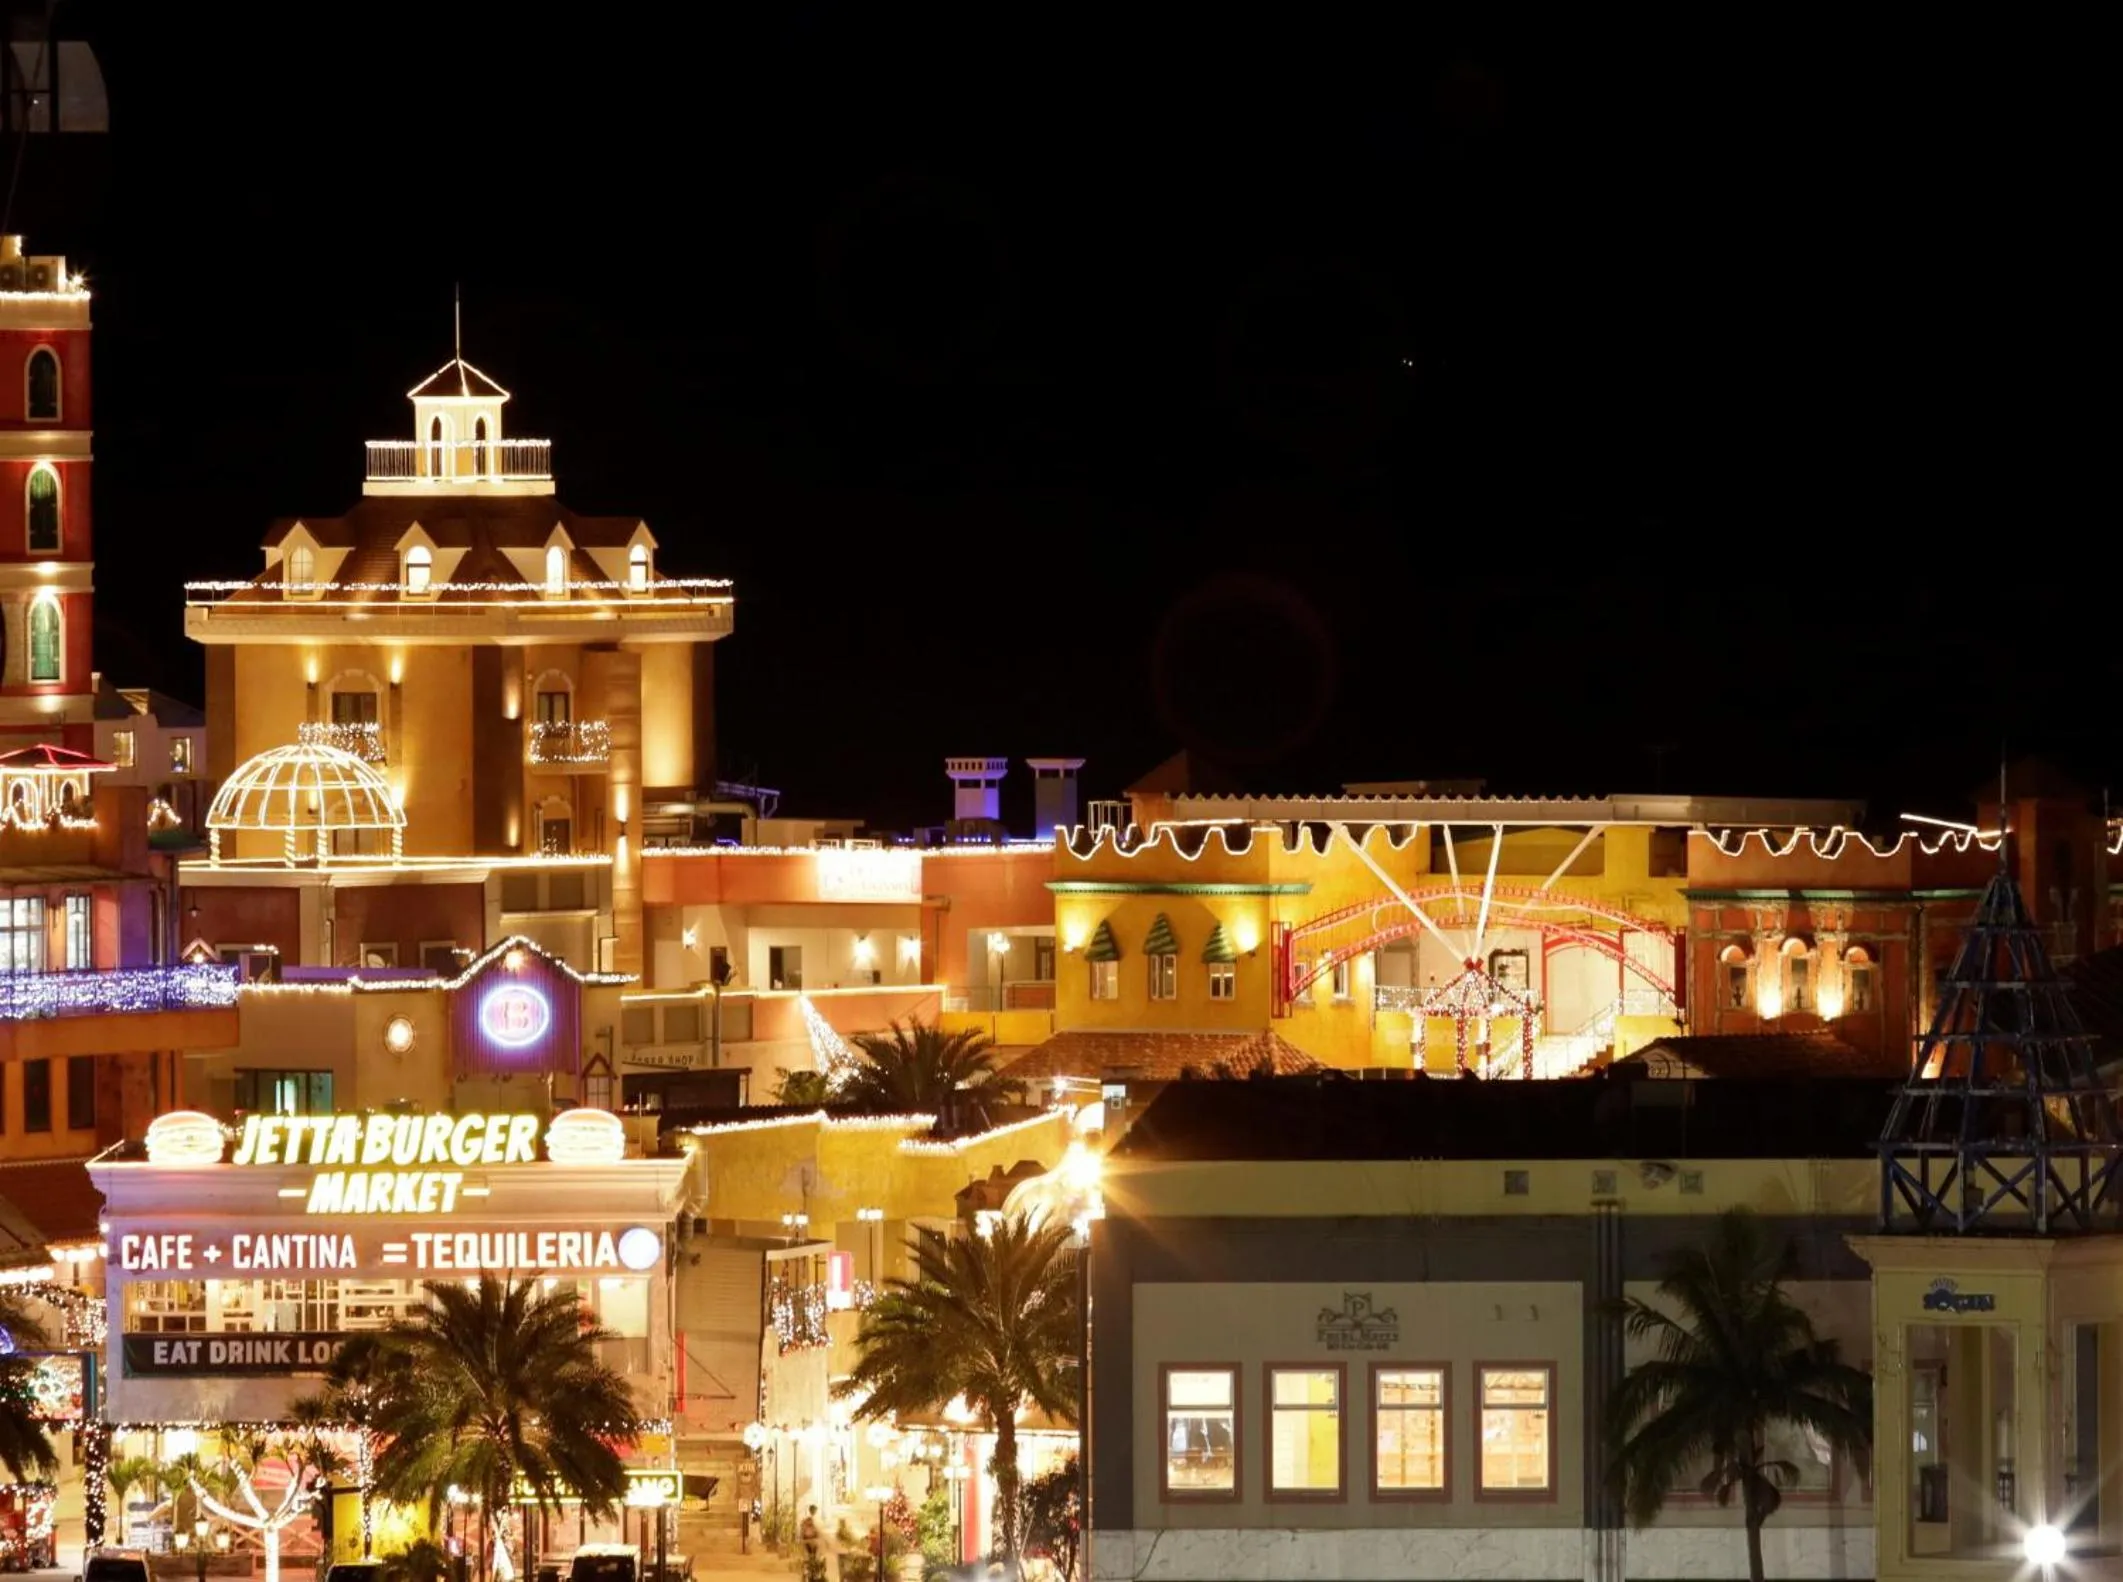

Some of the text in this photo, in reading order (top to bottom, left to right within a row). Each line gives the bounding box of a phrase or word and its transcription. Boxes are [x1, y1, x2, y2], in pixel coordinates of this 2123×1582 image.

[232, 1114, 539, 1165] JETTA BURGER
[306, 1171, 464, 1214] MARKET
[121, 1234, 194, 1269] CAFE
[232, 1234, 357, 1269] CANTINA
[154, 1340, 203, 1365] EAT
[209, 1340, 291, 1365] DRINK
